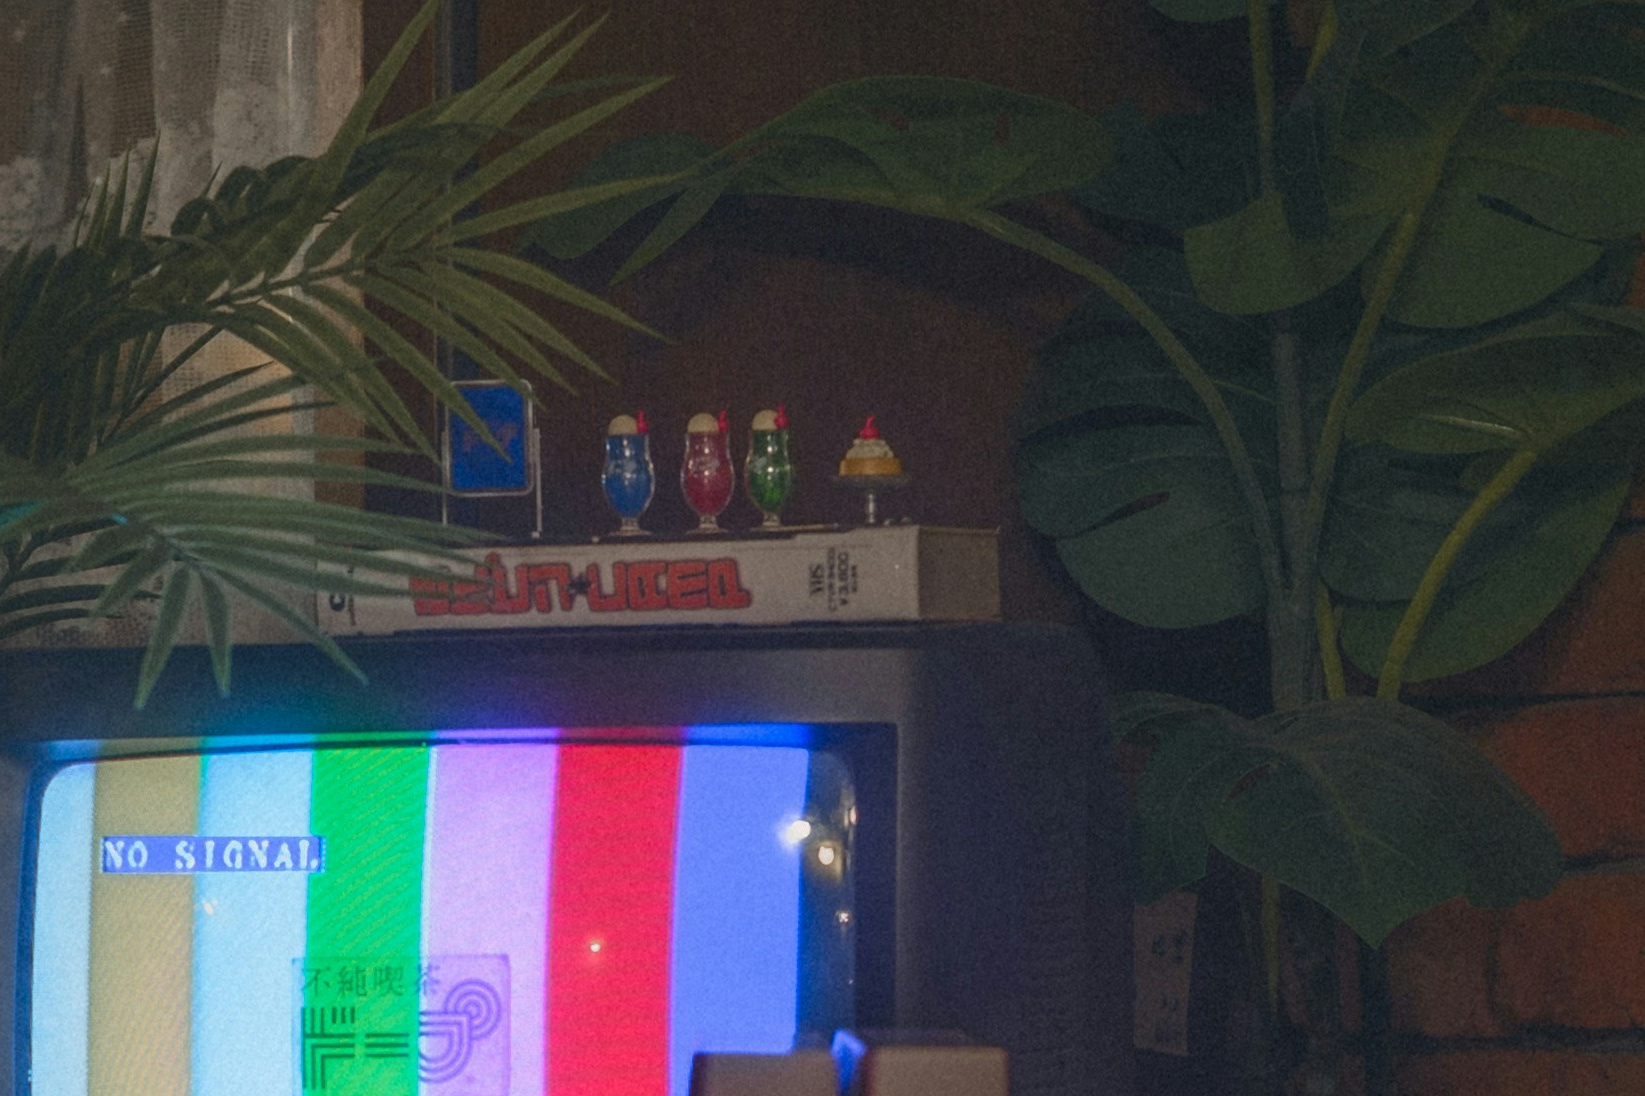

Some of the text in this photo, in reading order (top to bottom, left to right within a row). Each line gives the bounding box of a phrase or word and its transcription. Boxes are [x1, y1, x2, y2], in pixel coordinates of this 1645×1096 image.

[104, 840, 318, 870] NO SIGNAL
[302, 965, 441, 998] 不純喫茶
